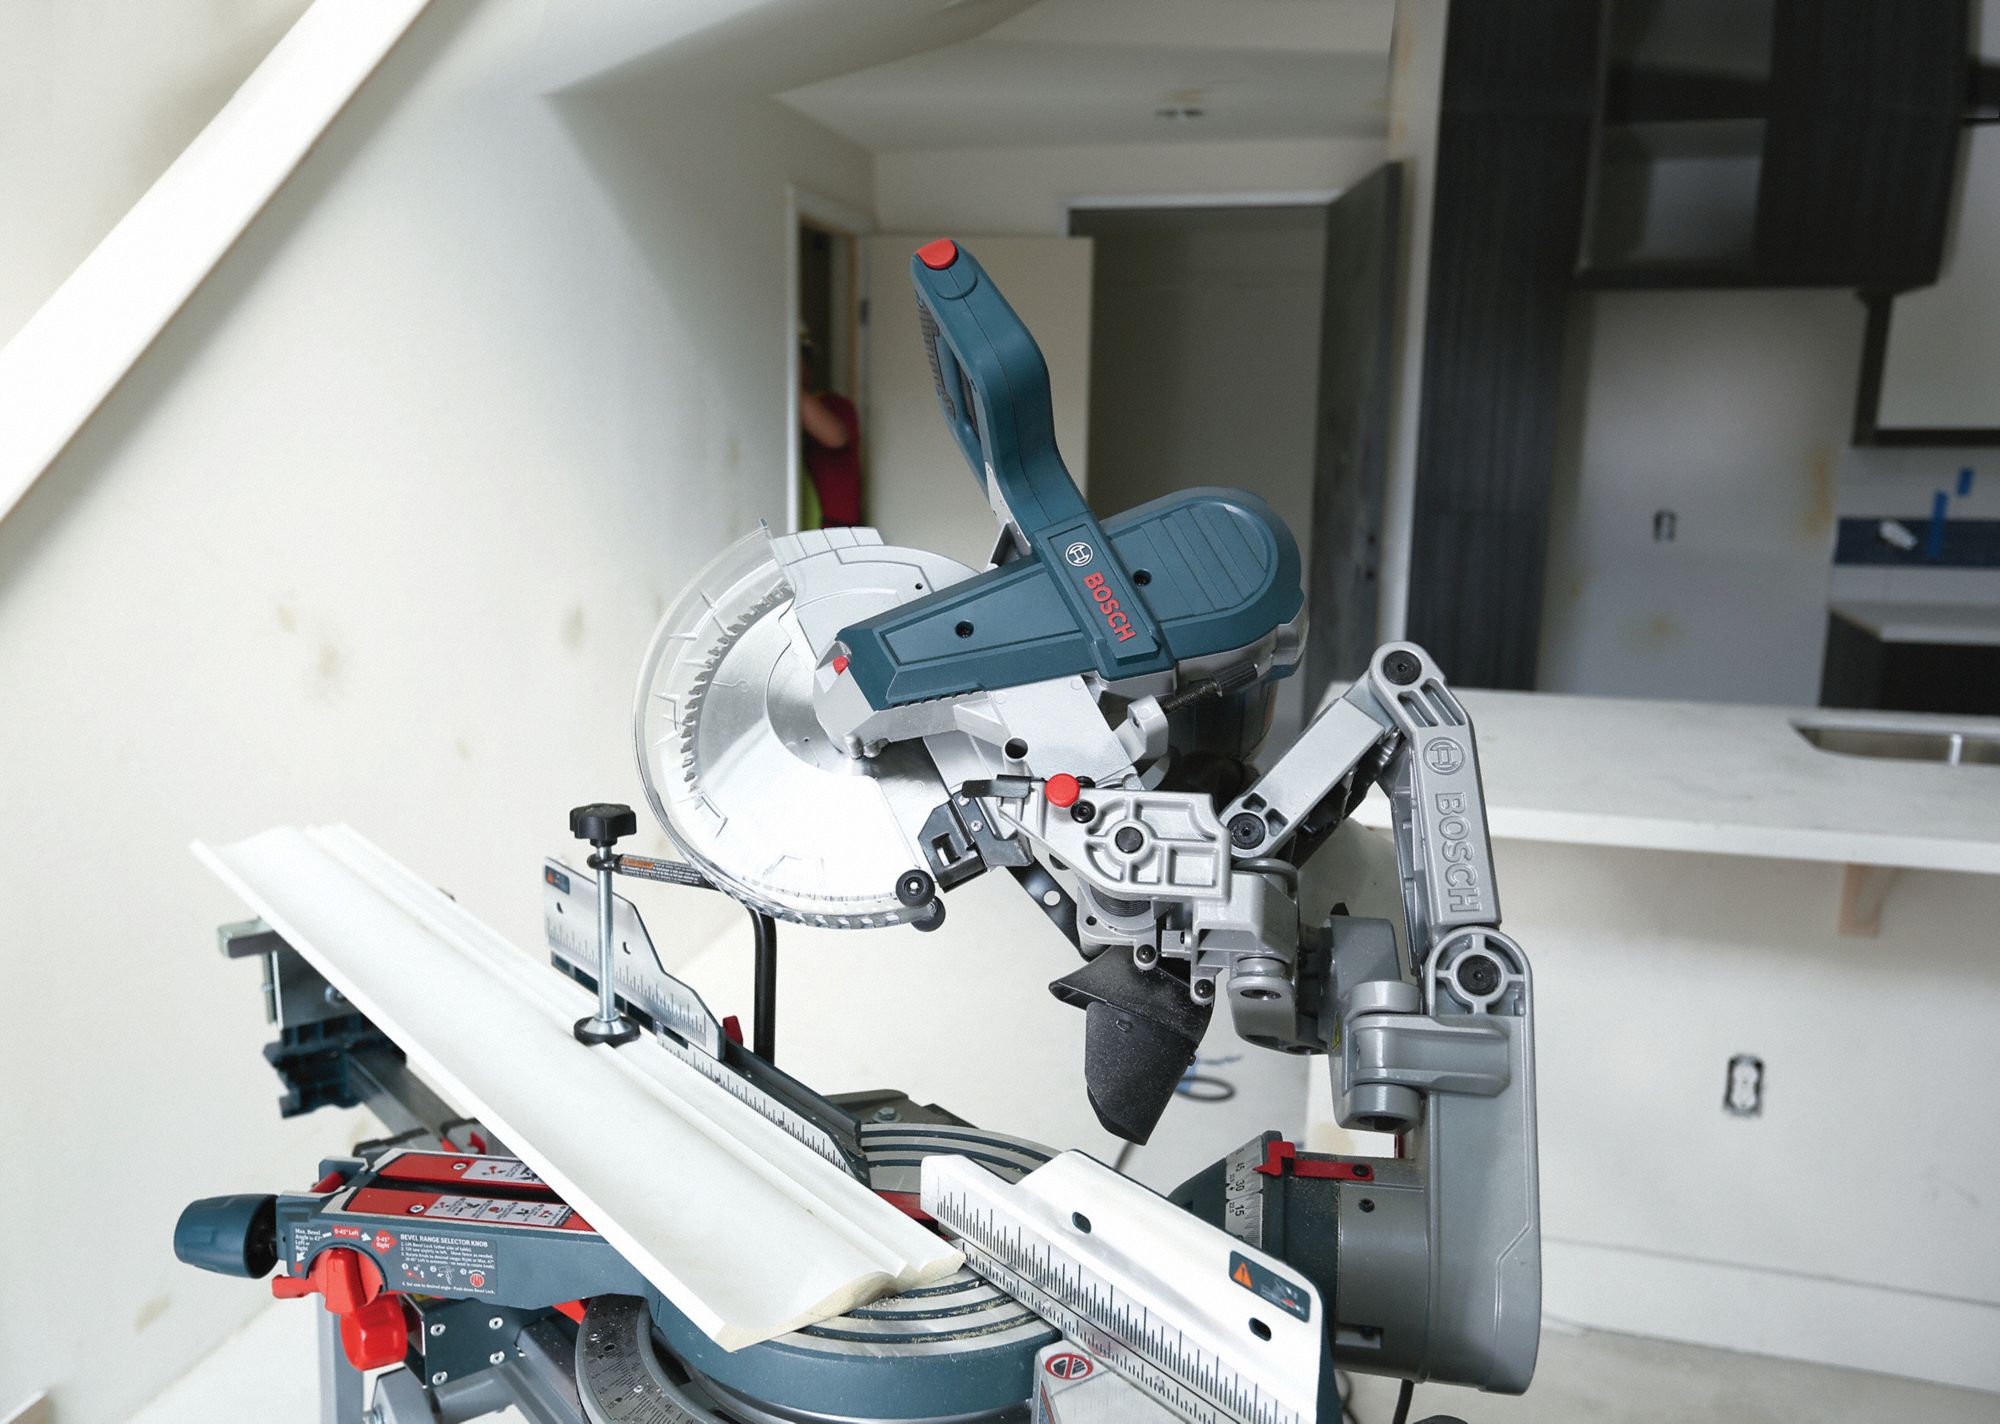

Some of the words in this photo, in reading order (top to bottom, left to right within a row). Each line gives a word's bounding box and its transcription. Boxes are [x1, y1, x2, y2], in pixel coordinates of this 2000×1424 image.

[1083, 571, 1137, 643] BOSCH
[1434, 791, 1482, 914] BOSCH
[1235, 1180, 1245, 1192] 30
[1235, 1205, 1245, 1217] 15
[376, 1241, 390, 1249] Right
[420, 1235, 440, 1243] RANGE
[440, 1237, 470, 1246] SELECTOR
